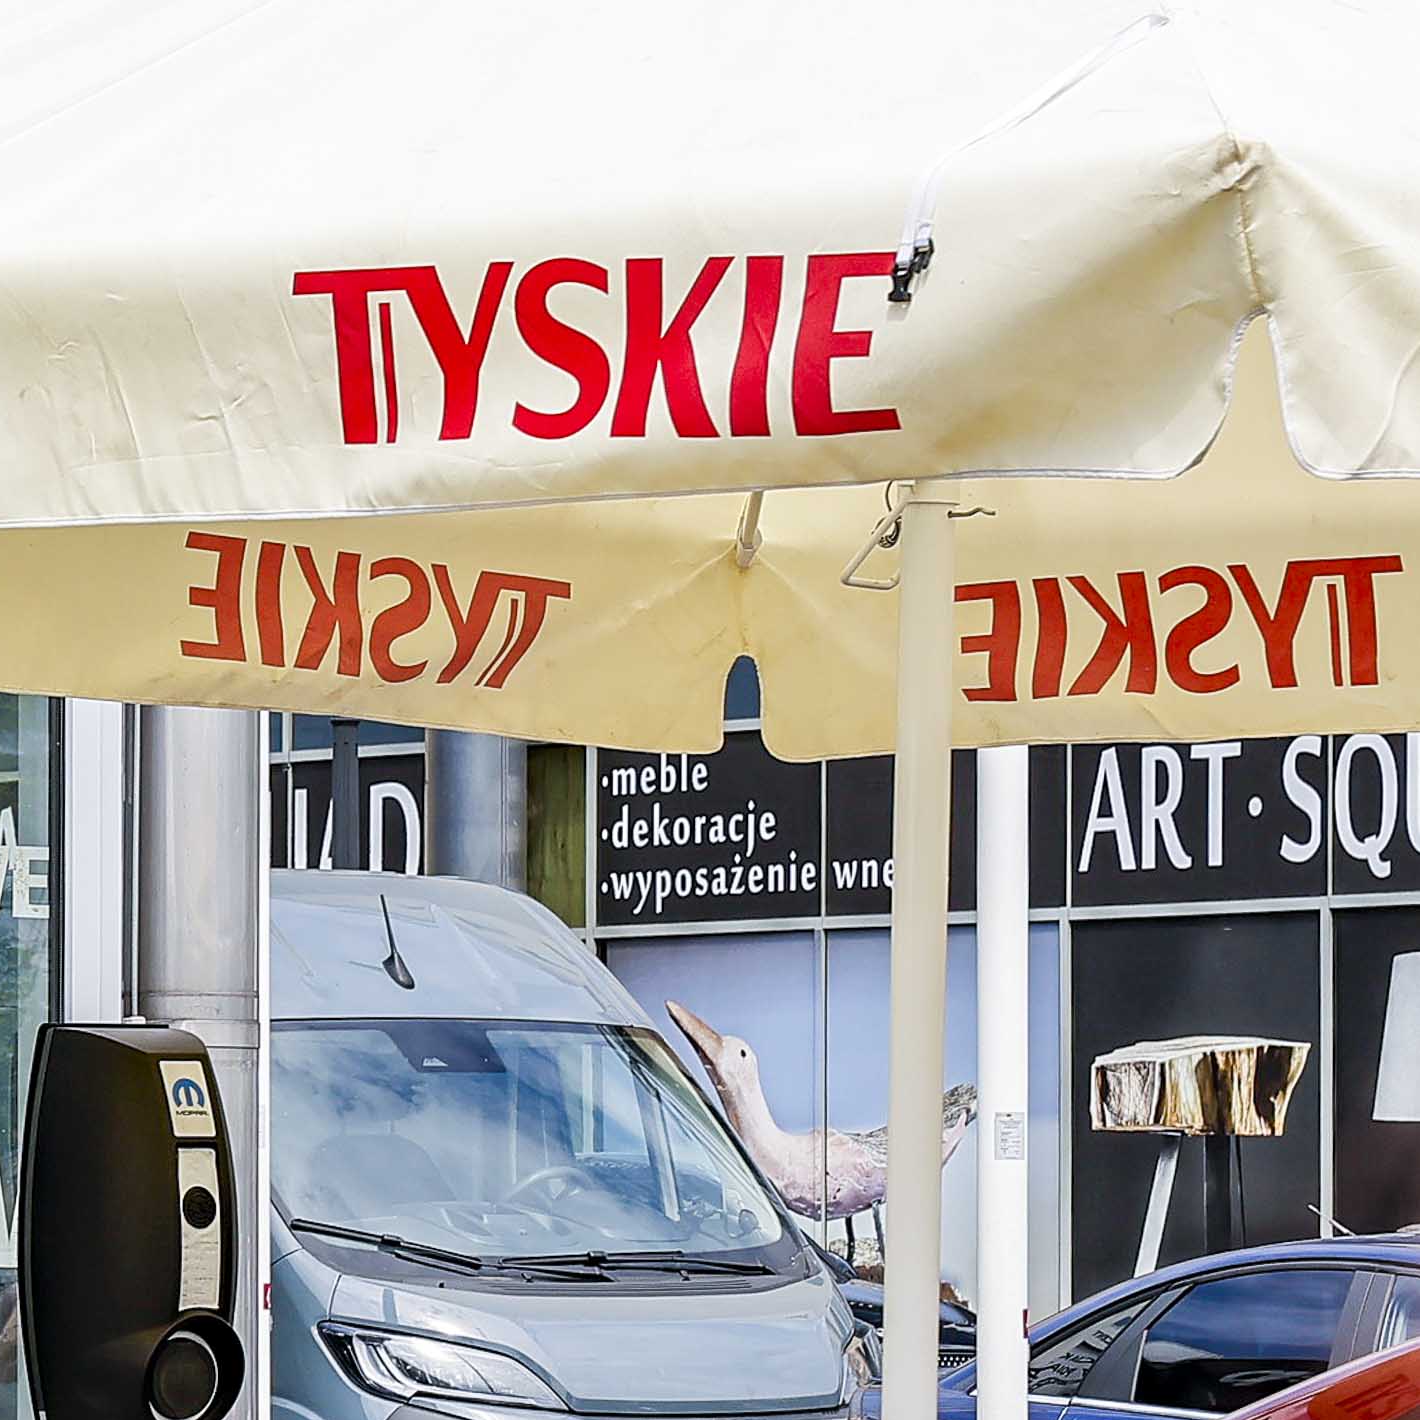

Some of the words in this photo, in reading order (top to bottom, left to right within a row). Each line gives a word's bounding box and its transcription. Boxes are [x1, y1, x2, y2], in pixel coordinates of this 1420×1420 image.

[292, 250, 903, 445] TYSKIE
[612, 752, 708, 796] meble
[612, 800, 777, 857] dekoracje
[610, 850, 817, 915] wyposażenie
